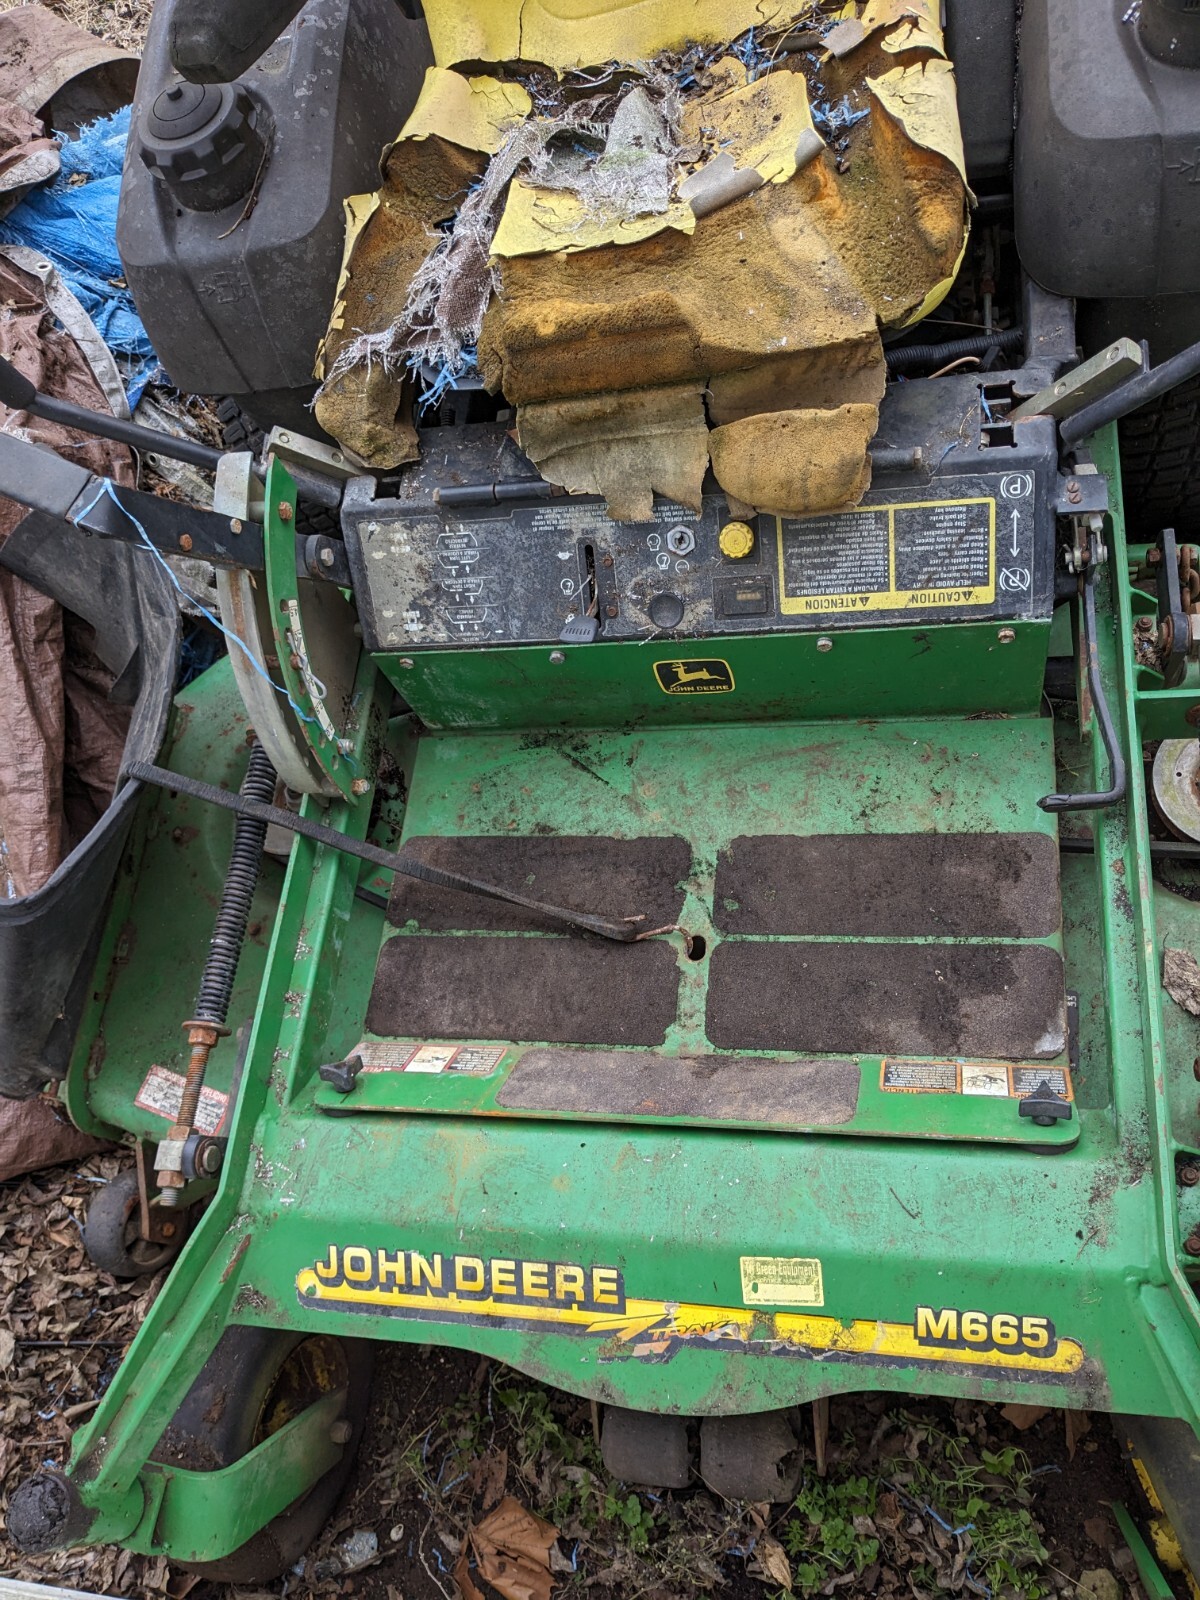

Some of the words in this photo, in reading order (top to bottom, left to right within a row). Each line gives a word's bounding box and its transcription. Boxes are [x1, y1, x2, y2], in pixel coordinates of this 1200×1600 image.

[805, 597, 857, 609] ATENCION
[911, 591, 960, 603] CAUTION
[315, 1243, 444, 1289] JOHN
[455, 1255, 620, 1306] DEERE
[916, 1306, 1049, 1349] M665
